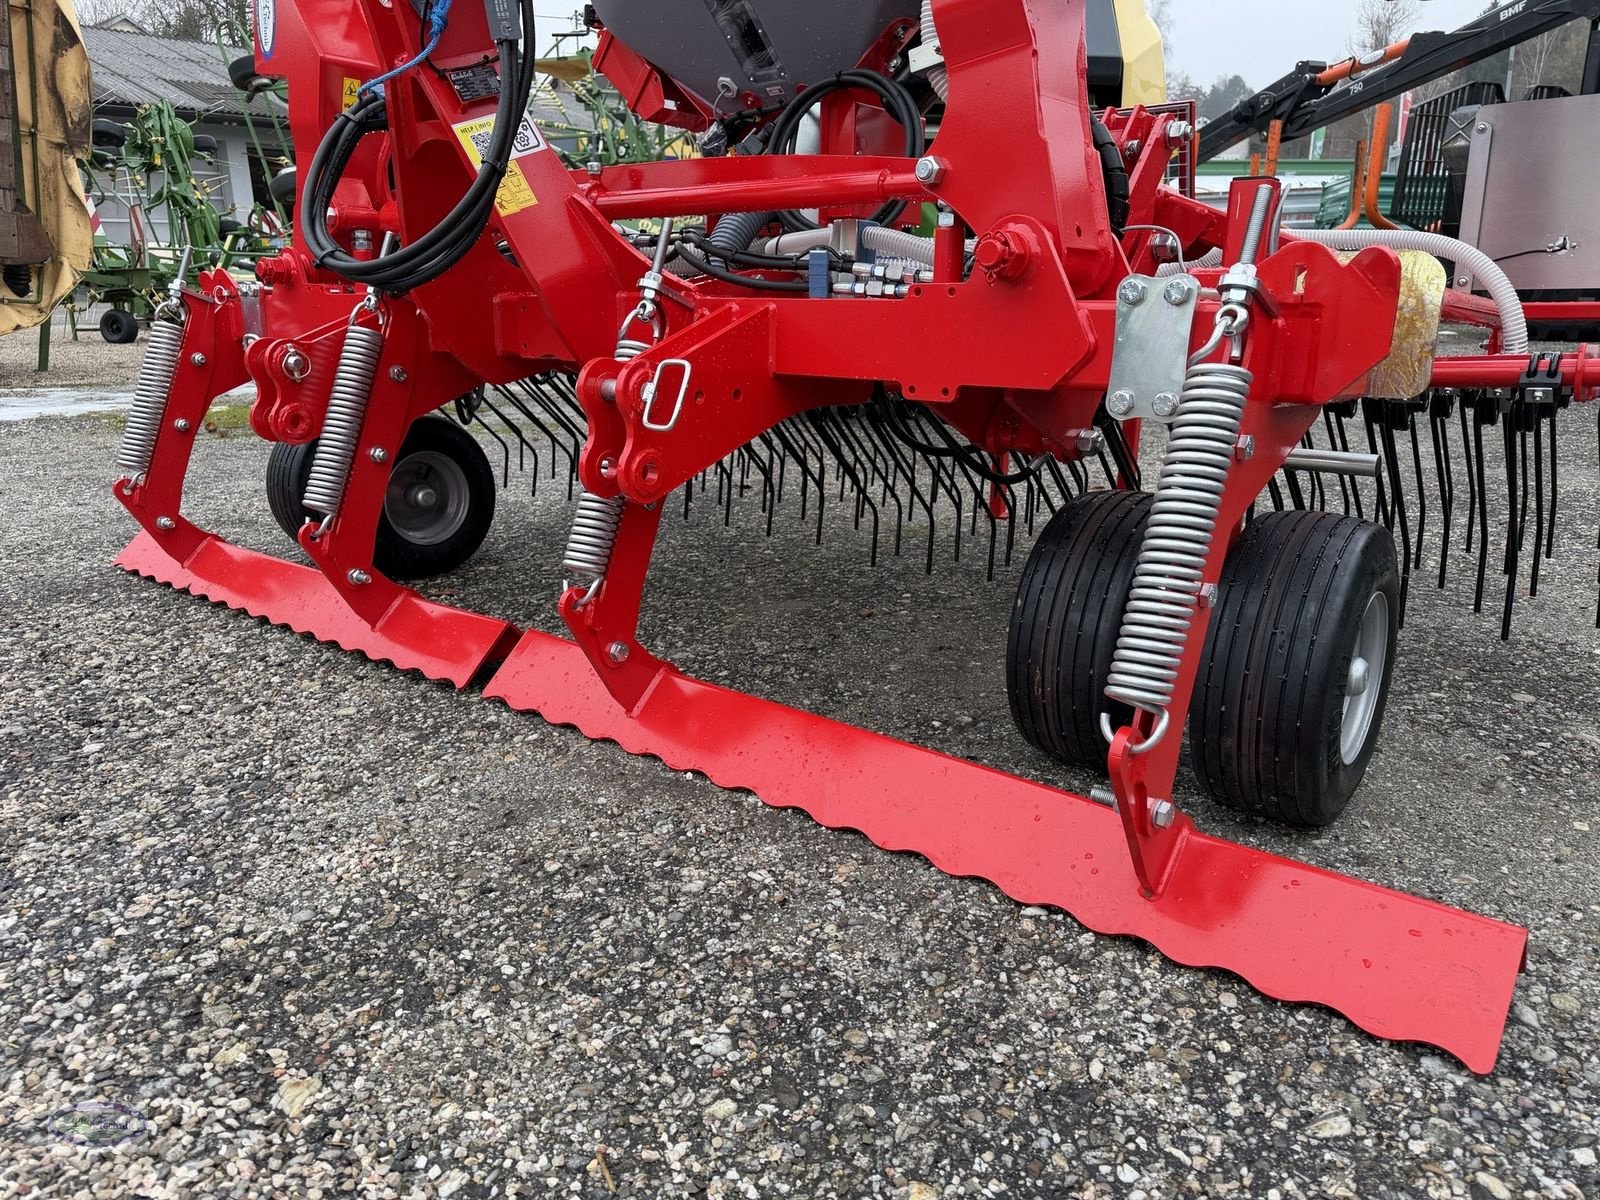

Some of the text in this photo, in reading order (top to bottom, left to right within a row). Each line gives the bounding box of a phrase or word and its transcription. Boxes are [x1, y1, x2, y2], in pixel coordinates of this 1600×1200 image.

[1500, 0, 1527, 21] BMF
[1349, 82, 1363, 95] 750
[460, 126, 474, 134] HELP
[479, 121, 492, 130] INFO
